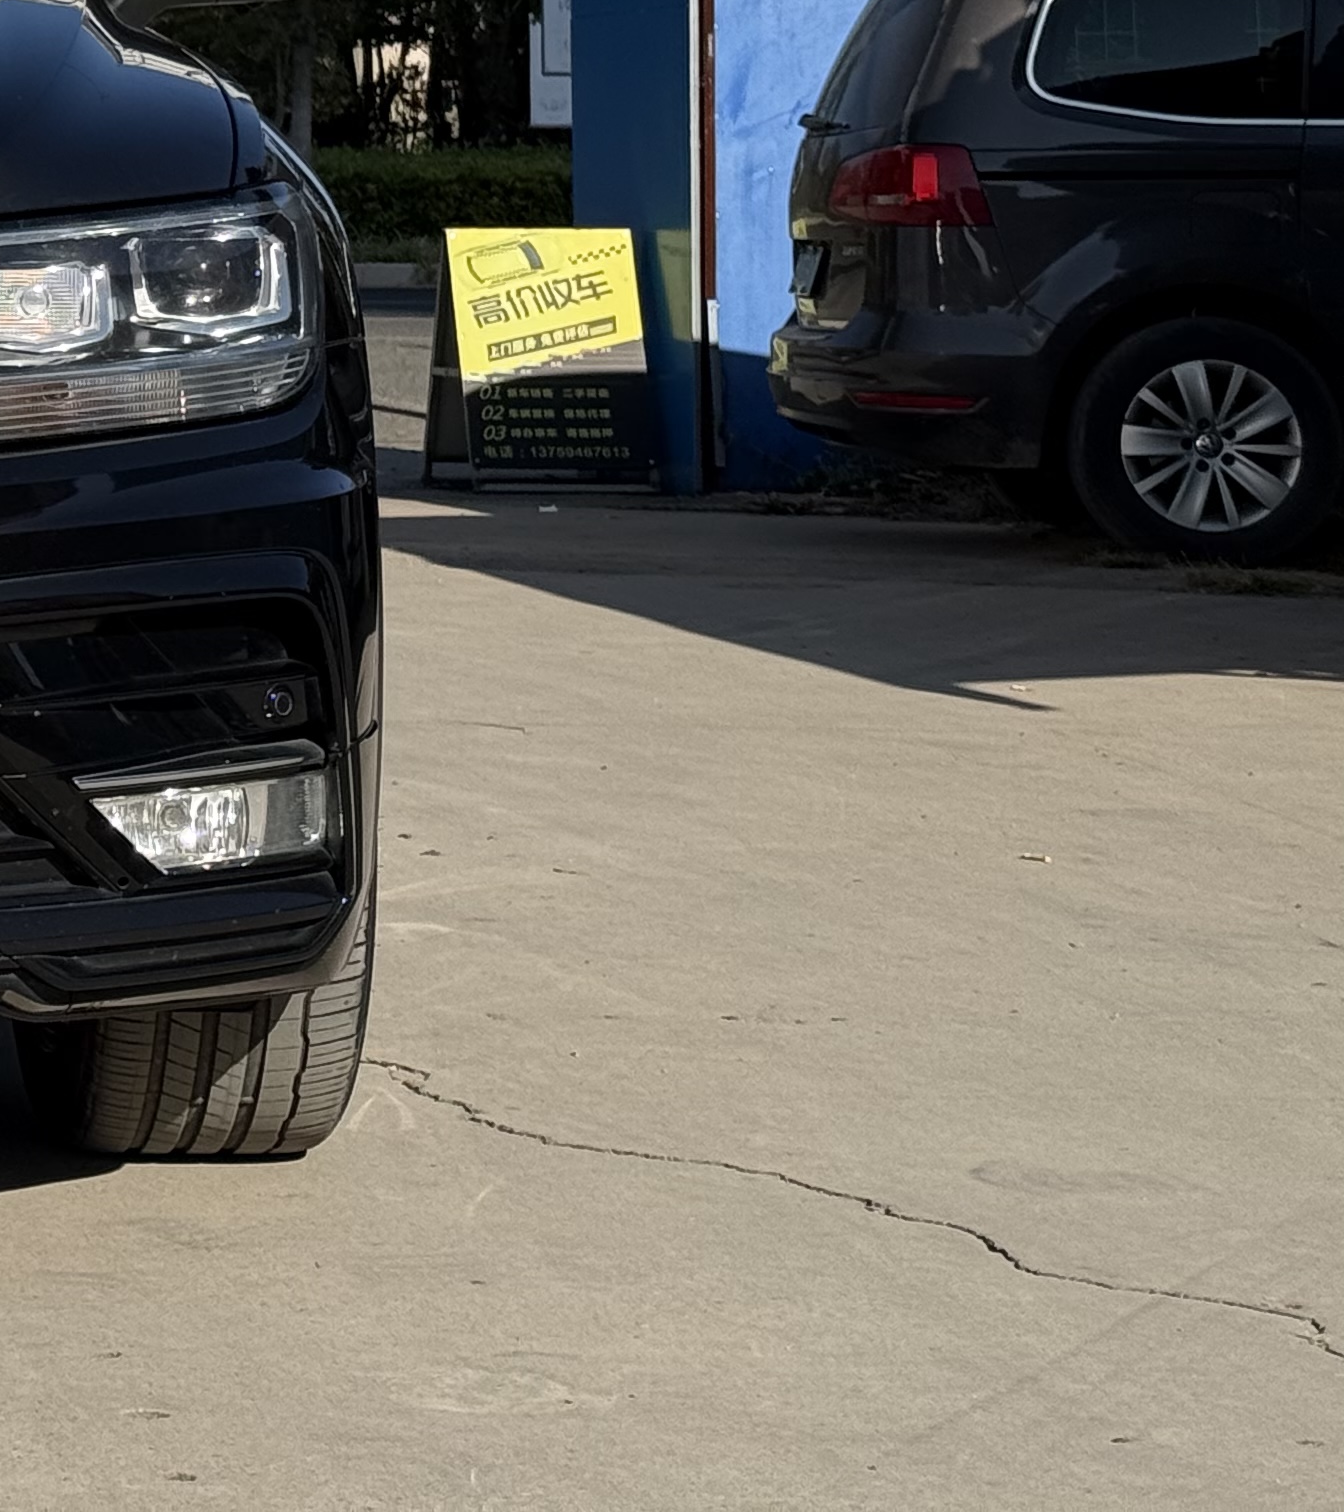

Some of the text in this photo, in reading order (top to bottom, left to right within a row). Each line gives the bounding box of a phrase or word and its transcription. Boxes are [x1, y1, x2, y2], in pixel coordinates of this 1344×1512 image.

[467, 270, 614, 329] 高价收车
[479, 385, 502, 401] 01
[481, 404, 505, 420] 02
[482, 424, 507, 441] 03
